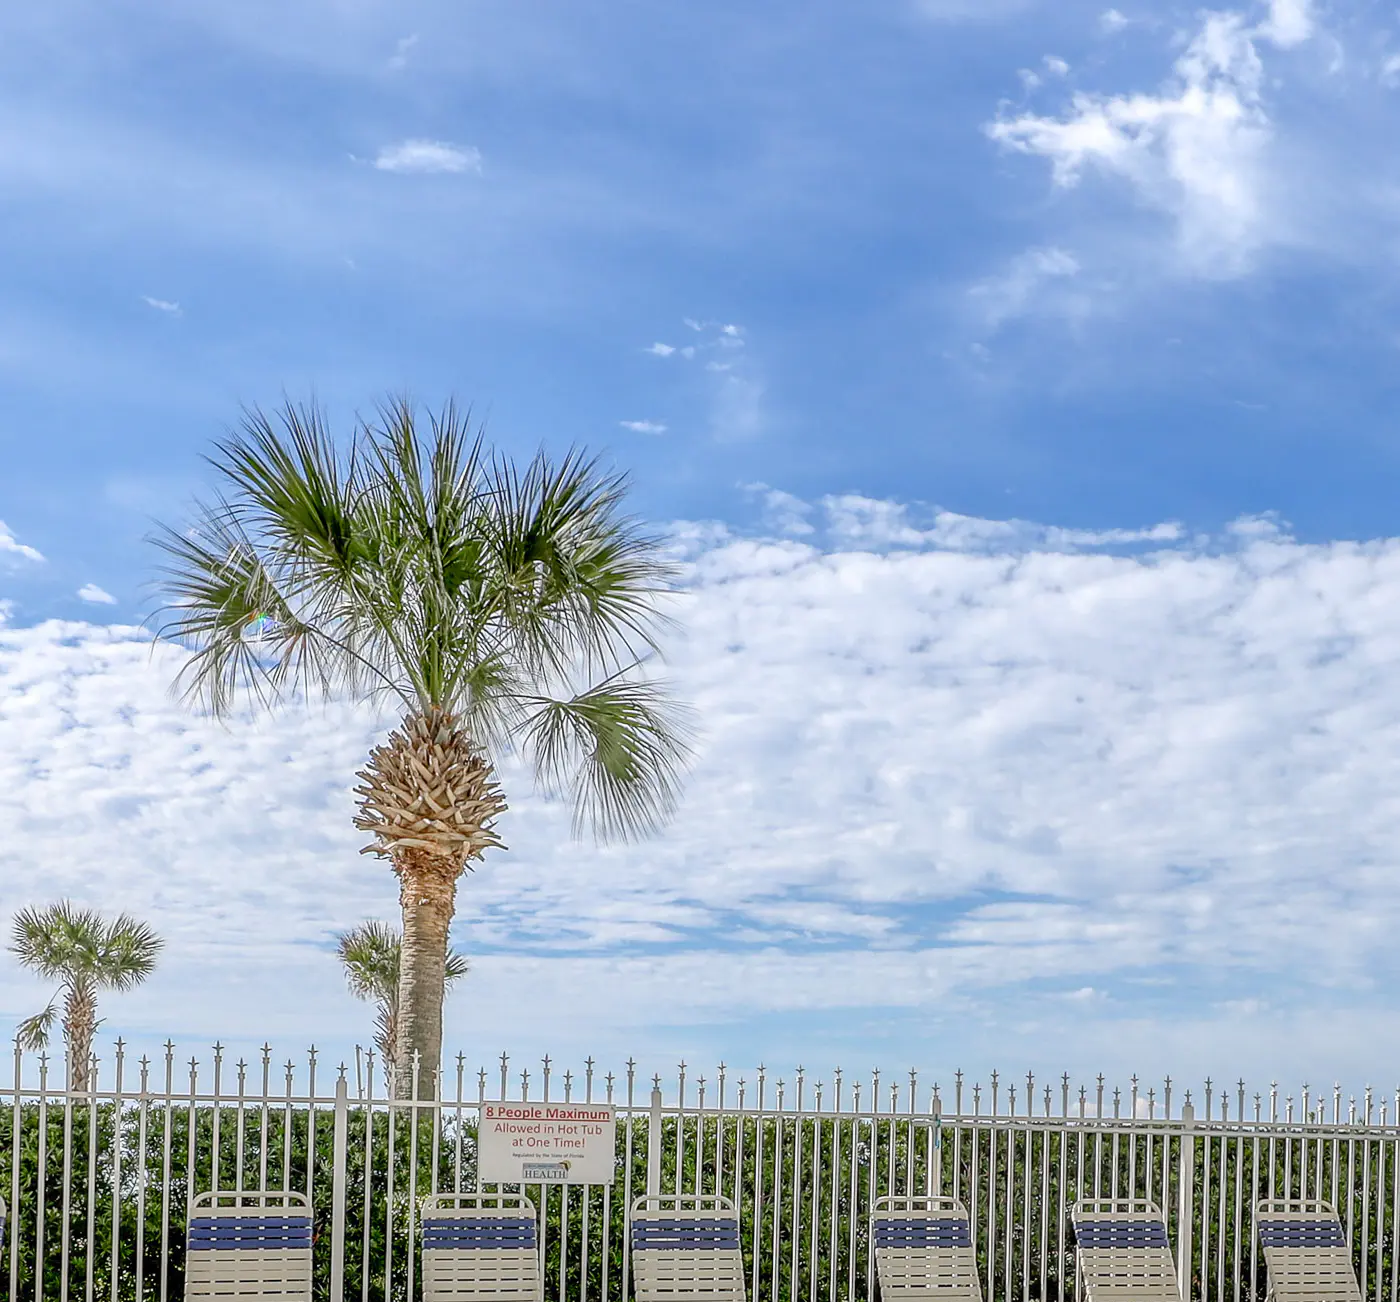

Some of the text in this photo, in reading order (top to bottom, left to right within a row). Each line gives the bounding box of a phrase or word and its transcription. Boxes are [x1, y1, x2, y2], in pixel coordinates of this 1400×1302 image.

[486, 1107, 610, 1119] 8 People Maximum
[494, 1123, 602, 1135] Allowed in Hot Tub
[512, 1138, 585, 1147] at One Time!
